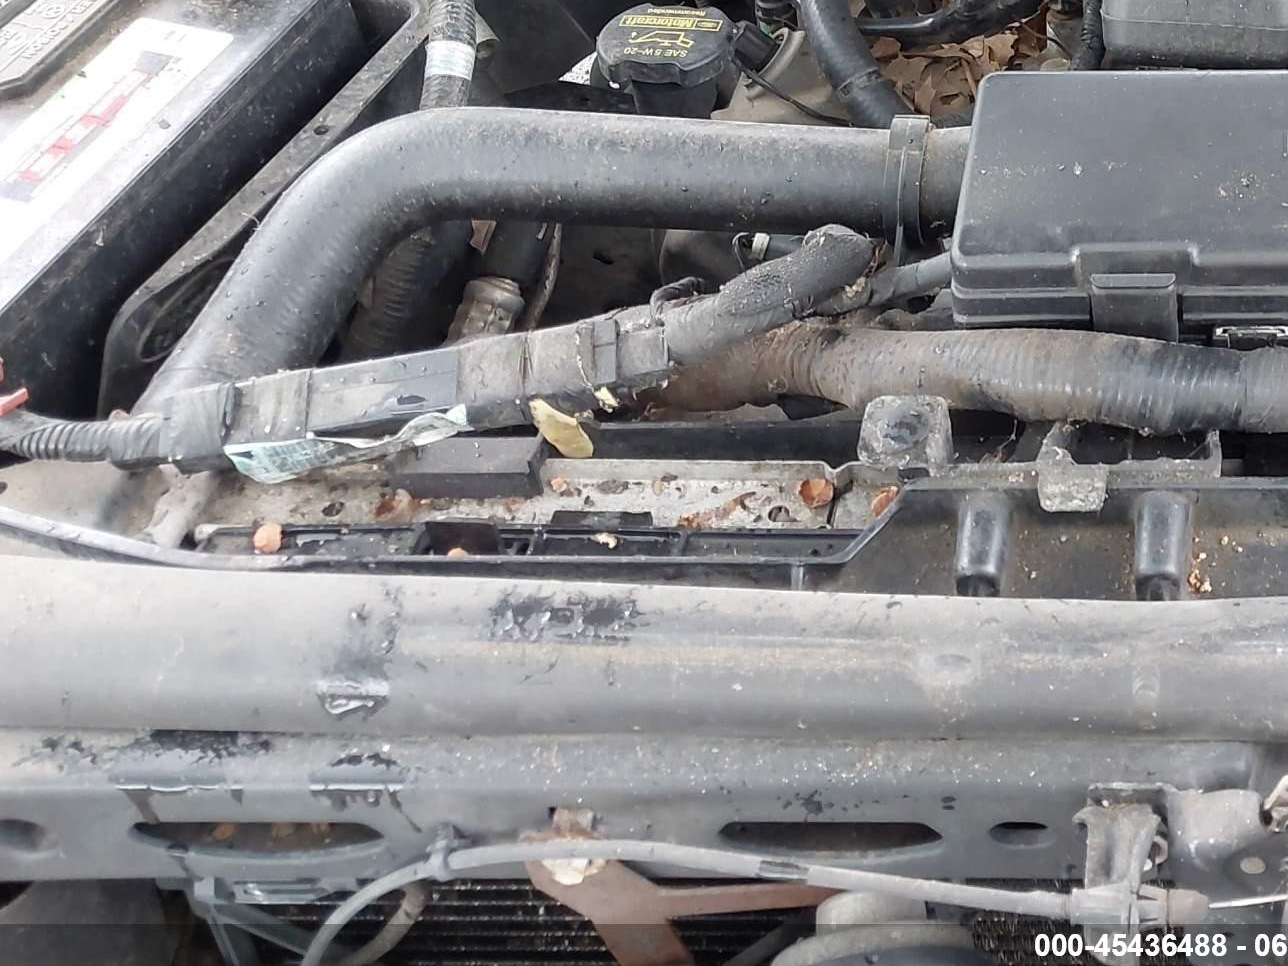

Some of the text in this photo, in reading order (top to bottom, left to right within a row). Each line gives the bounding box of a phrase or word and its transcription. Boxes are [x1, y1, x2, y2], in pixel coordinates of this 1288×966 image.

[647, 8, 706, 17] Recommended
[624, 17, 693, 28] Motorcraft
[664, 49, 688, 58] SAE
